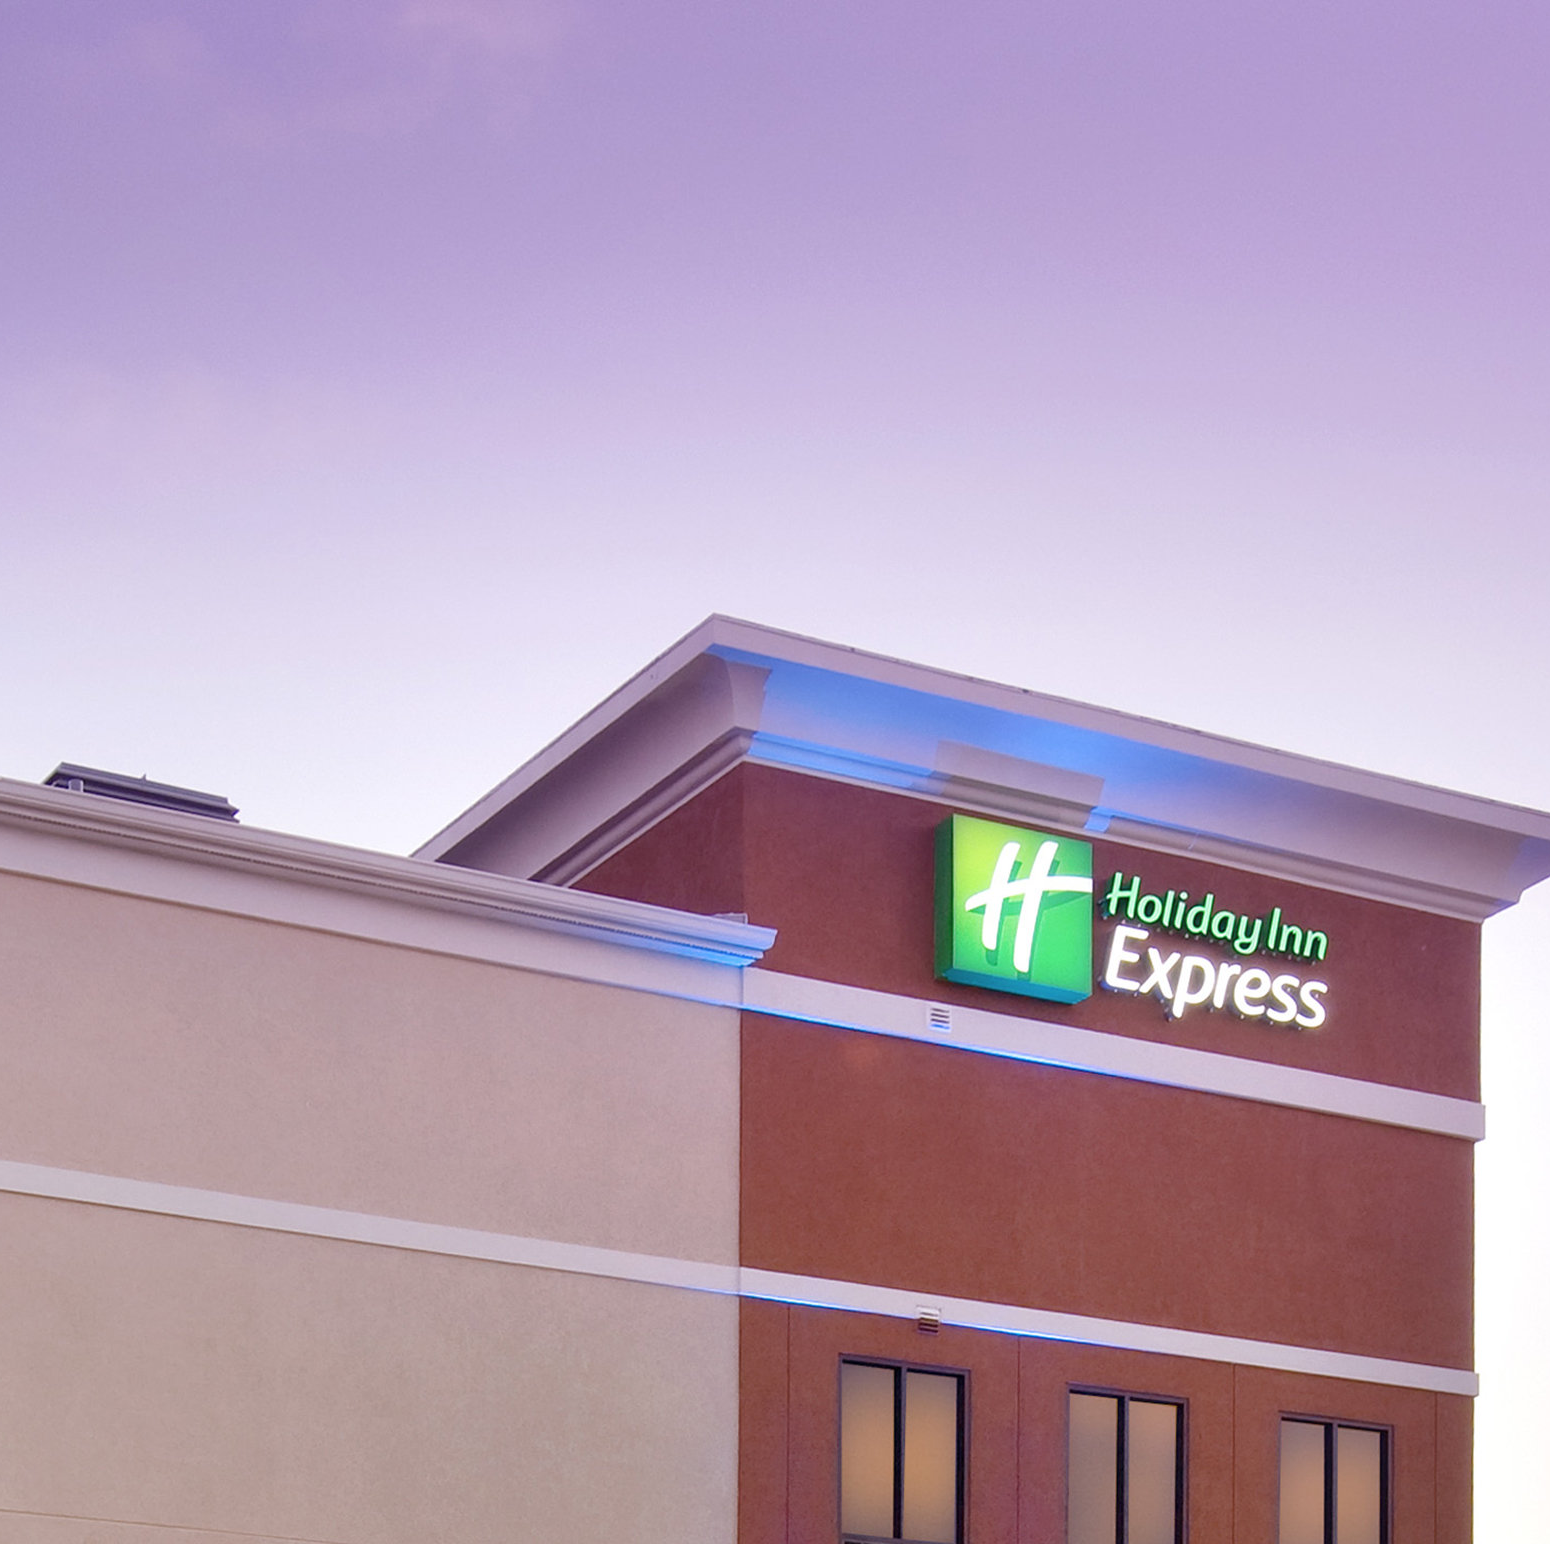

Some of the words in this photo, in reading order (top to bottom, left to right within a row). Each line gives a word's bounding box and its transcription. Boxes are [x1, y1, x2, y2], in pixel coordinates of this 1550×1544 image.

[1105, 871, 1264, 956] Holiday
[1267, 907, 1330, 961] Inn
[1103, 924, 1330, 1030] Express
